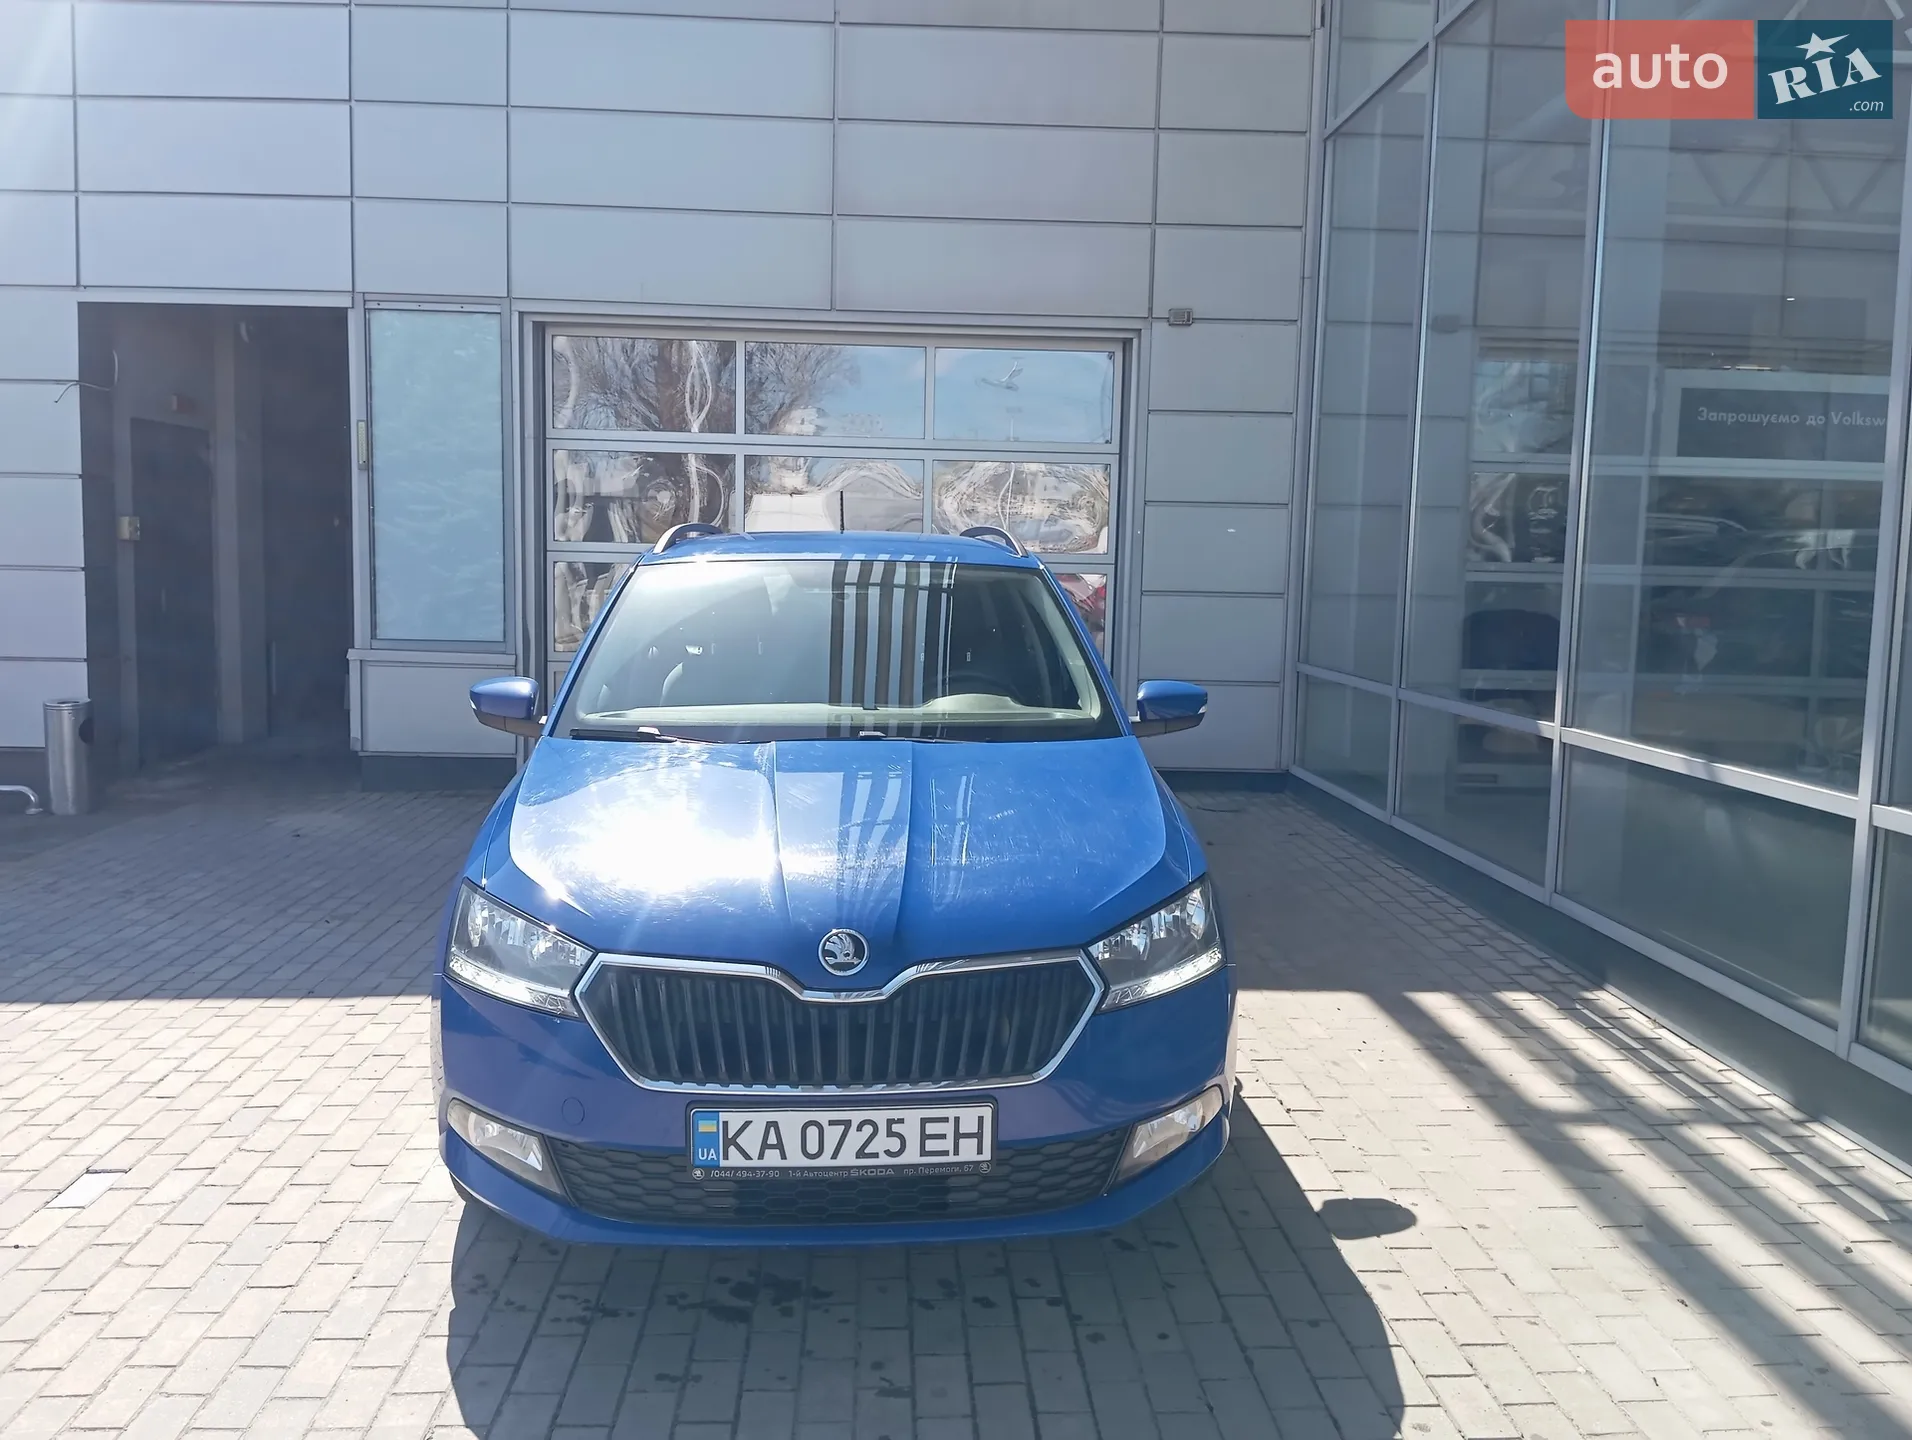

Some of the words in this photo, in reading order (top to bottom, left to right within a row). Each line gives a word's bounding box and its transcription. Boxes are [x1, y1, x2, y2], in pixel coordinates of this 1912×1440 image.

[1697, 406, 1800, 426] Запрошуємо
[1805, 413, 1826, 426] до
[721, 1120, 788, 1161] KA
[800, 1117, 907, 1161] 0725
[919, 1115, 984, 1158] EH
[698, 1147, 717, 1161] UA
[850, 1167, 895, 1176] ŠKODA
